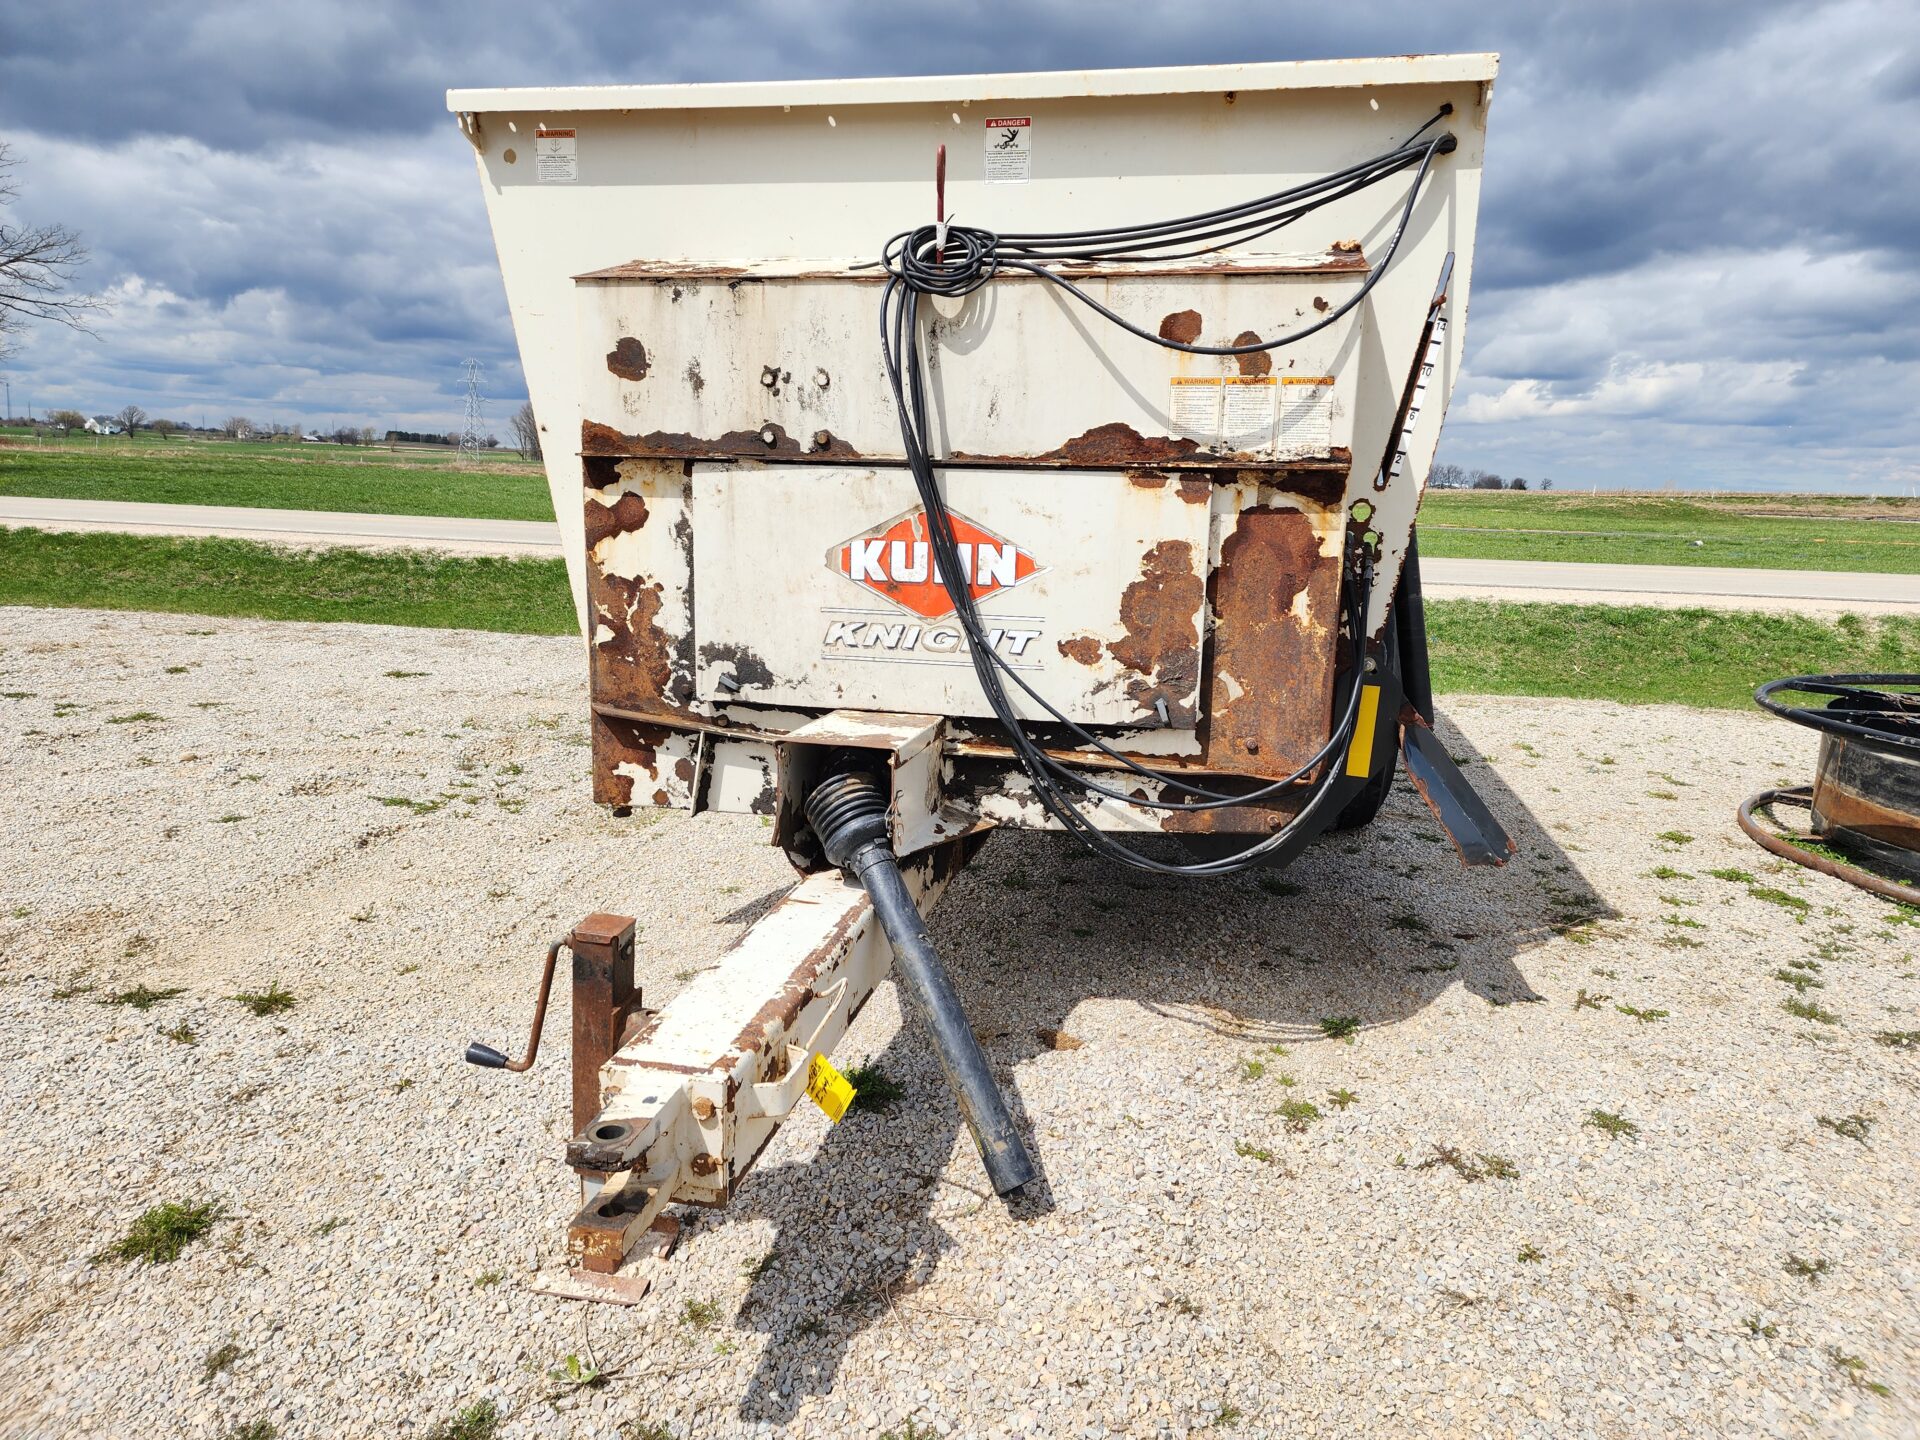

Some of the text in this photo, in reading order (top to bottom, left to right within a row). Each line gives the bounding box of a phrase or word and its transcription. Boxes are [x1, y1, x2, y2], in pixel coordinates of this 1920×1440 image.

[997, 119, 1026, 127] DANGER
[1436, 322, 1447, 331] 14
[1422, 367, 1433, 377] 10
[1184, 377, 1215, 385] WARNING
[1239, 377, 1271, 385] WARNING
[1409, 411, 1416, 421] 6
[1395, 454, 1402, 464] 2
